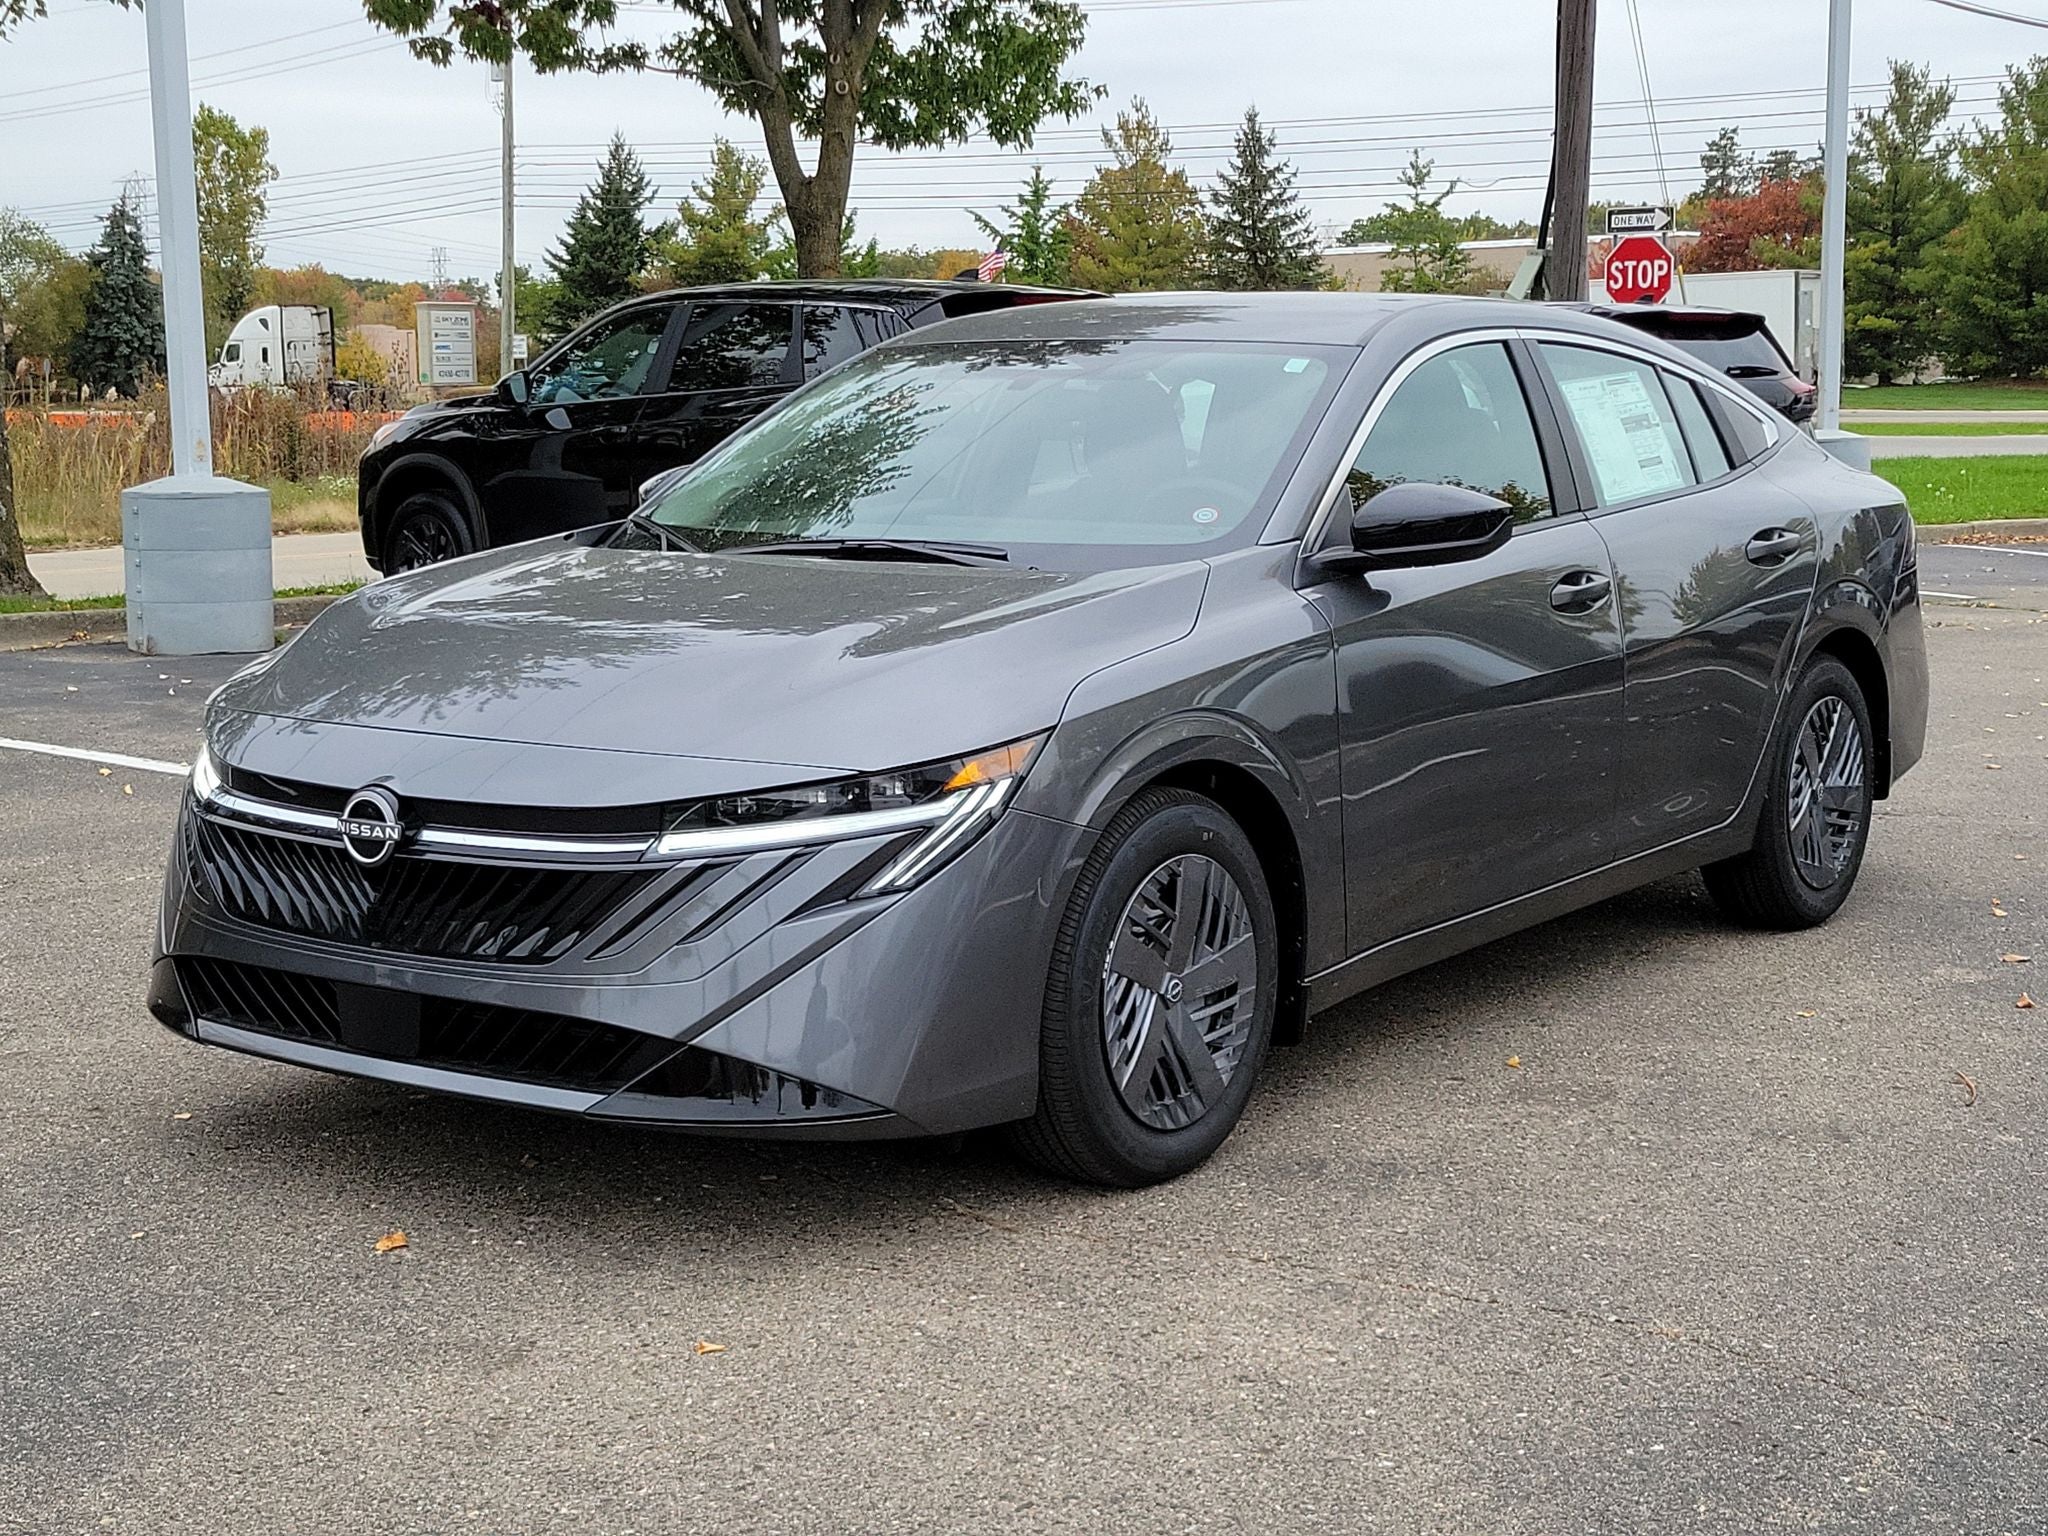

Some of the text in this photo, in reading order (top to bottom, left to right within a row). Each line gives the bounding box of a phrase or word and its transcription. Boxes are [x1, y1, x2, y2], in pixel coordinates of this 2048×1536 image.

[1613, 214, 1655, 226] ONE WAY
[1609, 259, 1668, 290] STOP
[337, 819, 399, 839] NISSAN
